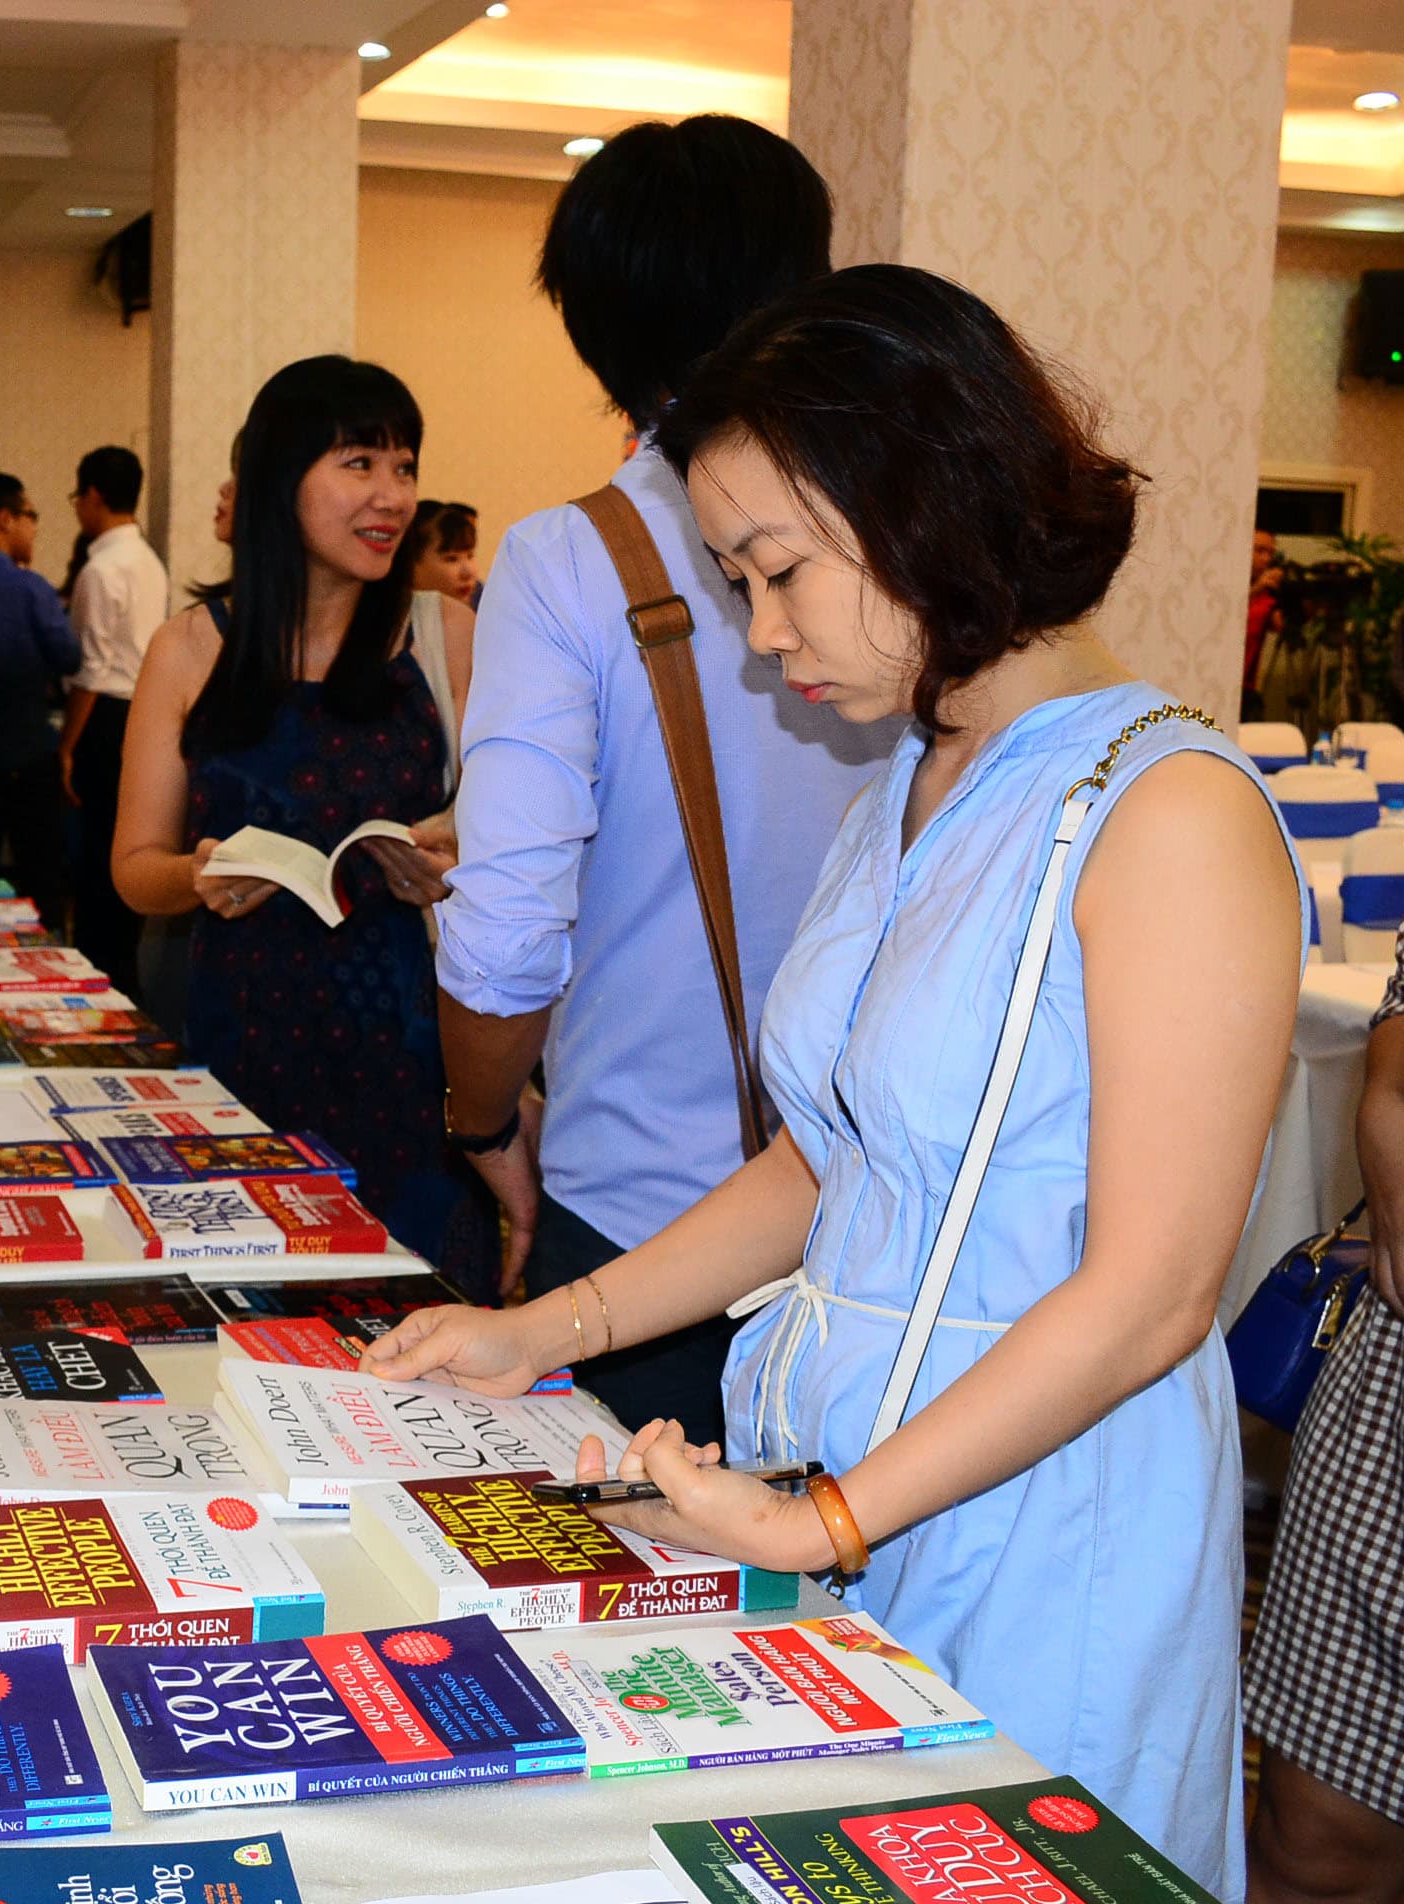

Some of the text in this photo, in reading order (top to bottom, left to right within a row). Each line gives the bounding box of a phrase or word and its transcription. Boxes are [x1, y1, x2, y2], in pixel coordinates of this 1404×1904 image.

[169, 1242, 278, 1259] FIRST THINGS FIRST
[43, 1340, 107, 1391] CHẾT
[257, 1373, 299, 1424] Doerr
[94, 1411, 194, 1481] QUAN
[167, 1412, 249, 1481] TRỌNG
[286, 1427, 330, 1468] John
[381, 1388, 494, 1470] QUAN
[452, 1399, 551, 1470] TRỌNG
[321, 1483, 349, 1496] John
[139, 1511, 195, 1577] THÓI QUEN
[417, 1490, 499, 1568] THE 7 HABITS OF
[443, 1492, 541, 1562] HIGHLY
[475, 1479, 597, 1574] EFFECTIVE
[15, 1507, 97, 1608] EFFECTIVE
[64, 1517, 137, 1590] PEOPLE
[167, 1577, 243, 1599] 7
[457, 1599, 494, 1613] Stephen
[510, 1603, 576, 1618] EFFECTIVE
[521, 1594, 569, 1608] HIGHLY
[597, 1582, 625, 1620] 7
[618, 1595, 729, 1617] ĐỂ THÀNH ĐẠT
[628, 1577, 719, 1597] THÓI QUEN
[95, 1623, 124, 1646] 7
[127, 1617, 230, 1639] THÓI QUEN
[519, 1615, 566, 1627] PEOPLE
[600, 1671, 630, 1693] The
[631, 1654, 710, 1721] Minute
[651, 1646, 753, 1728] Manager
[707, 1660, 761, 1702] Sales
[731, 1651, 801, 1708] Person
[747, 1634, 859, 1728] NGƯỜI BÁN HÀNG
[789, 1651, 834, 1680] PHÚT
[148, 1662, 237, 1753] YOU
[204, 1661, 296, 1751] CAN
[260, 1658, 356, 1746] WIN
[331, 1663, 393, 1733] BÍ QUYẾT CỦA
[345, 1645, 431, 1747] NGƯỜI CHIẾN THẮNG
[462, 1675, 520, 1738] DIFFERENTLY.
[822, 1680, 863, 1705] MỘT
[604, 1709, 646, 1749] Spencer
[829, 1742, 844, 1750] The
[844, 1741, 860, 1749] One
[936, 1729, 988, 1744] First News
[607, 1764, 636, 1777] Spencer
[669, 1759, 687, 1769] M.D.
[727, 1753, 744, 1764] BÁN
[771, 1749, 791, 1761] MỘT
[791, 1746, 814, 1757] PHÚT
[1012, 1816, 1036, 1835] JR.
[730, 1826, 790, 1881] HILL'S
[814, 1832, 879, 1896] THINKING
[868, 1824, 947, 1887] KHÓA
[896, 1821, 1006, 1891] DUY
